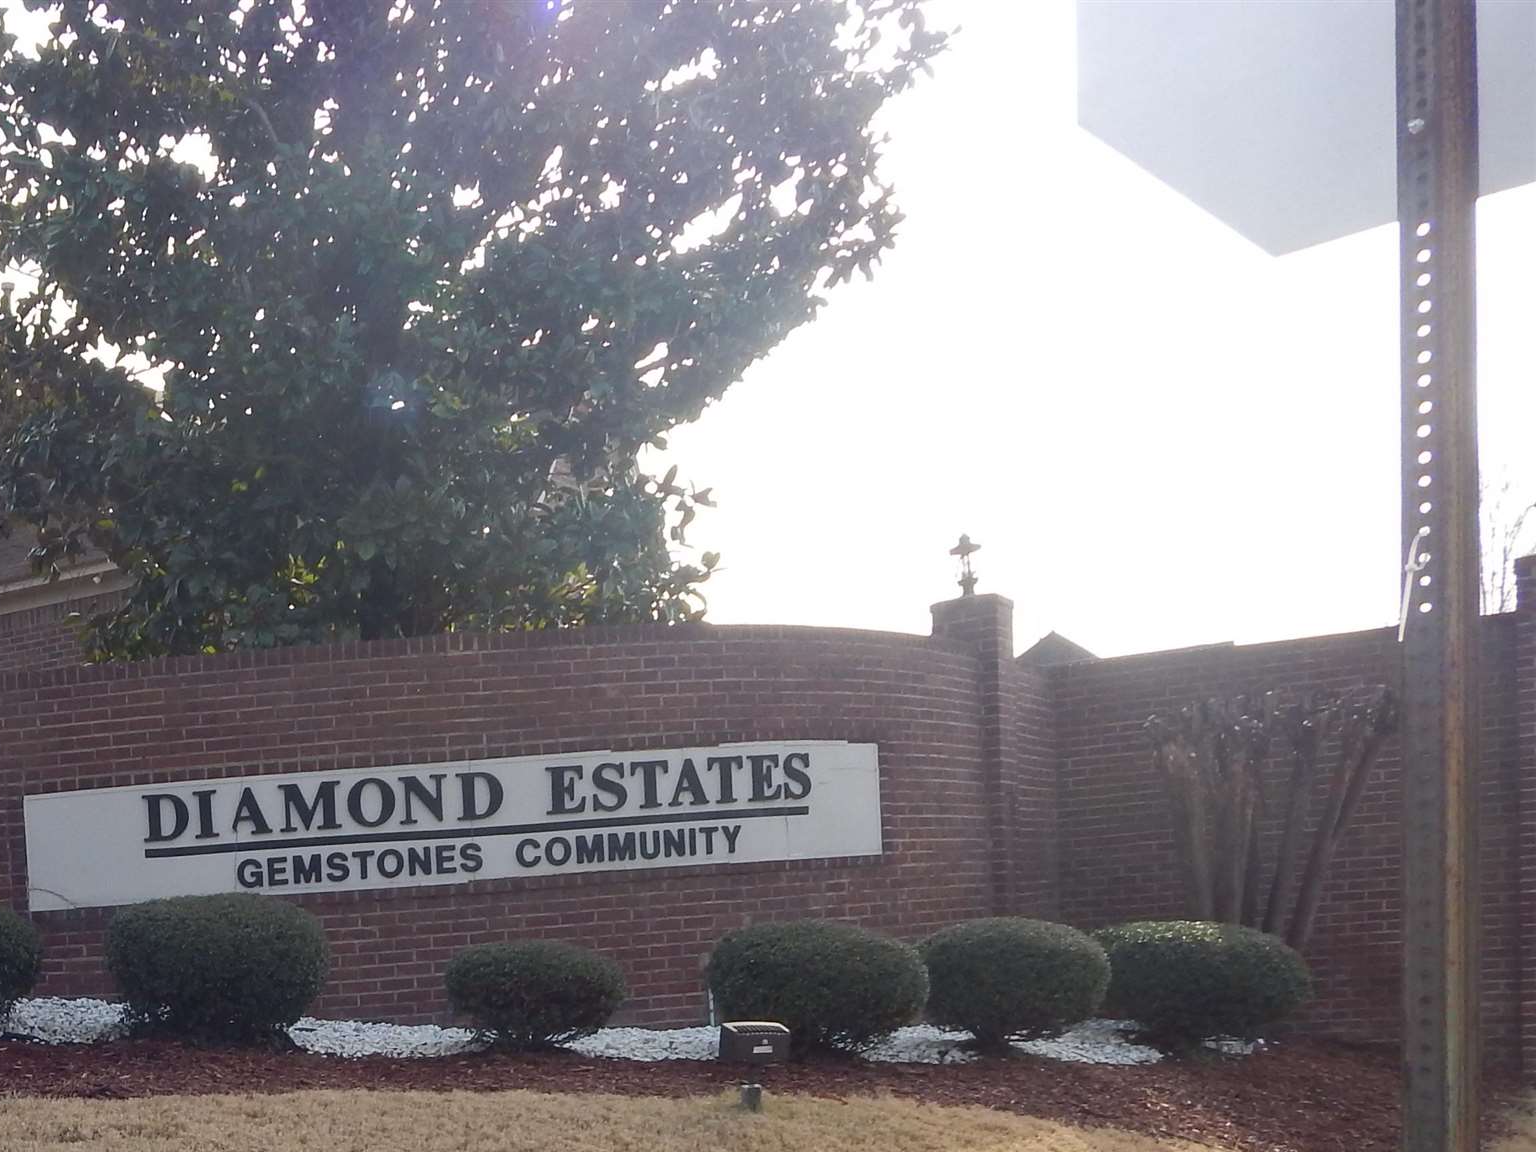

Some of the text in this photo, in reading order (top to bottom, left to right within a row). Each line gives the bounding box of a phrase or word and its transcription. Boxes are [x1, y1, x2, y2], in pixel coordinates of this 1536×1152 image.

[142, 752, 812, 843] DIAMOND ESTATES
[236, 826, 742, 888] GEMSTONES COMMUNITY
